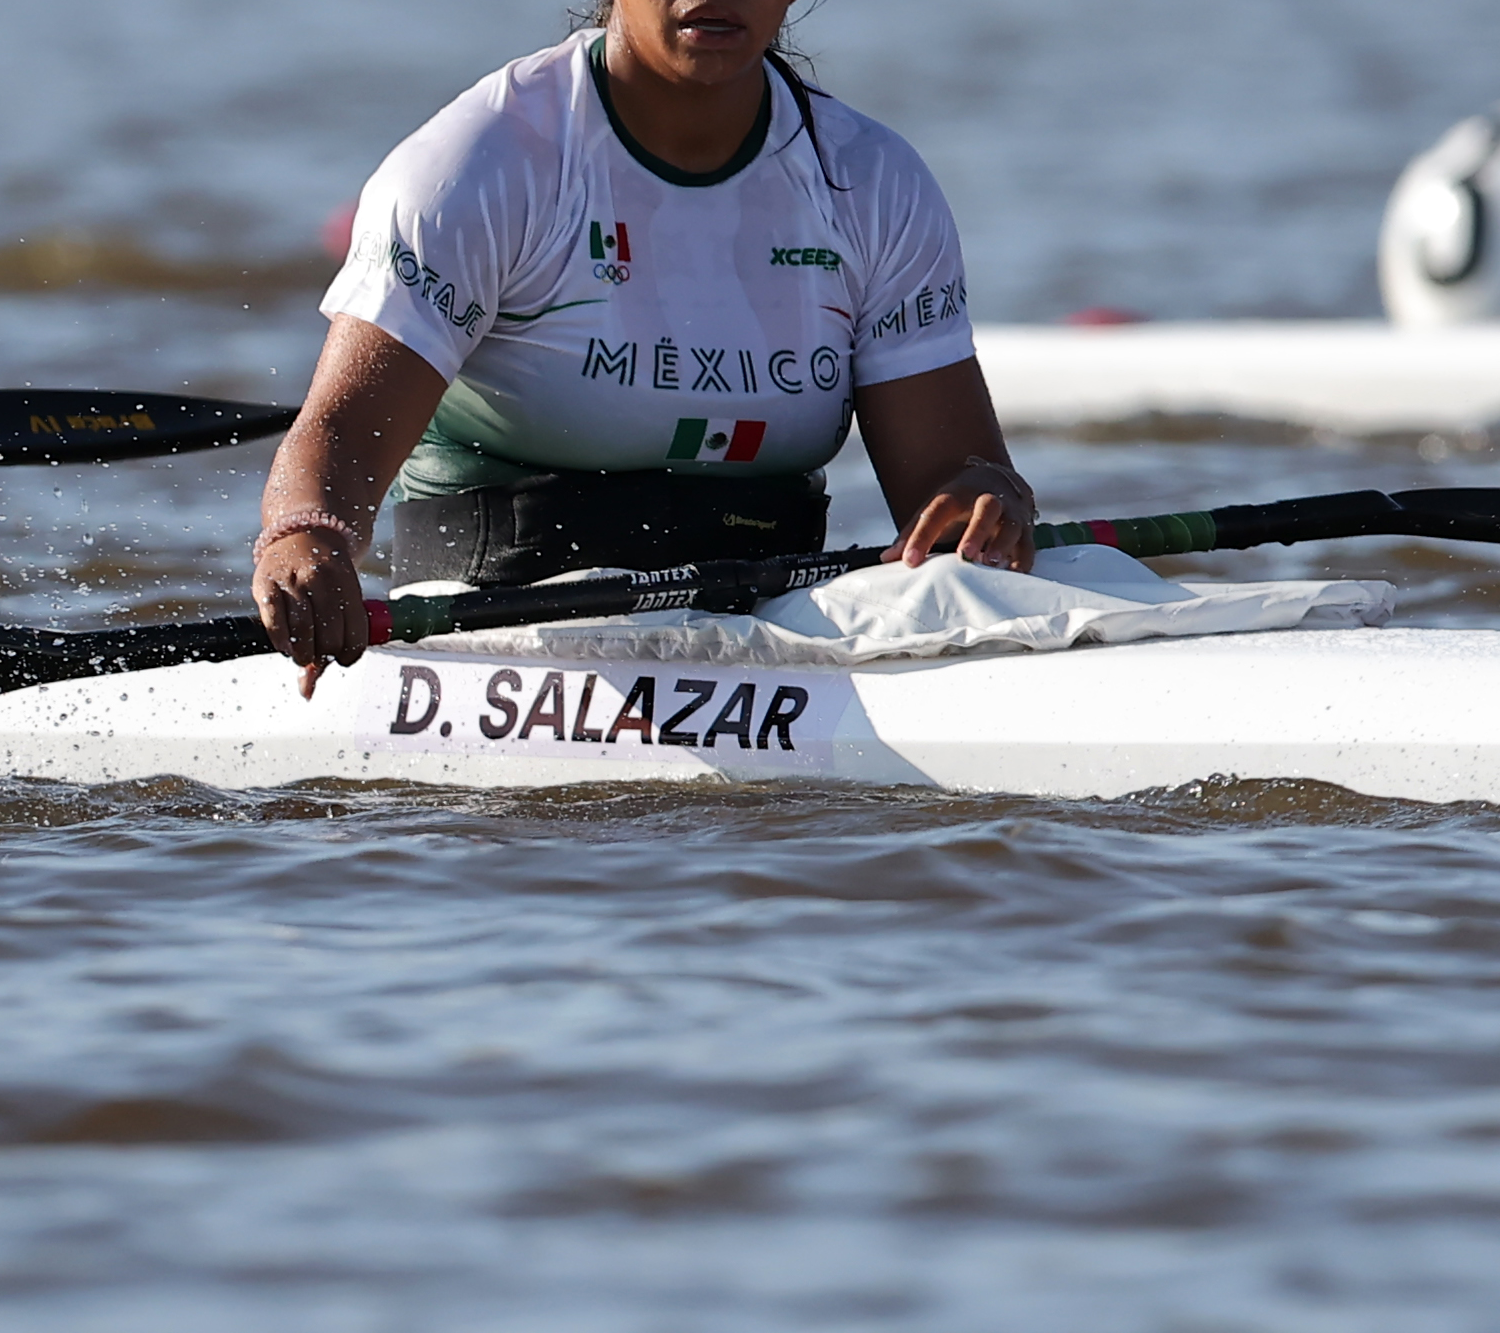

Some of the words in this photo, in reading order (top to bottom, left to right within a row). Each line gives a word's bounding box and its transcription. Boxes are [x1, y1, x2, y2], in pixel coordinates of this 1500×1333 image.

[355, 231, 487, 338] CANOTAJE
[770, 247, 842, 267] XCEED
[389, 664, 453, 738] D.
[478, 668, 809, 751] SALAZAR
